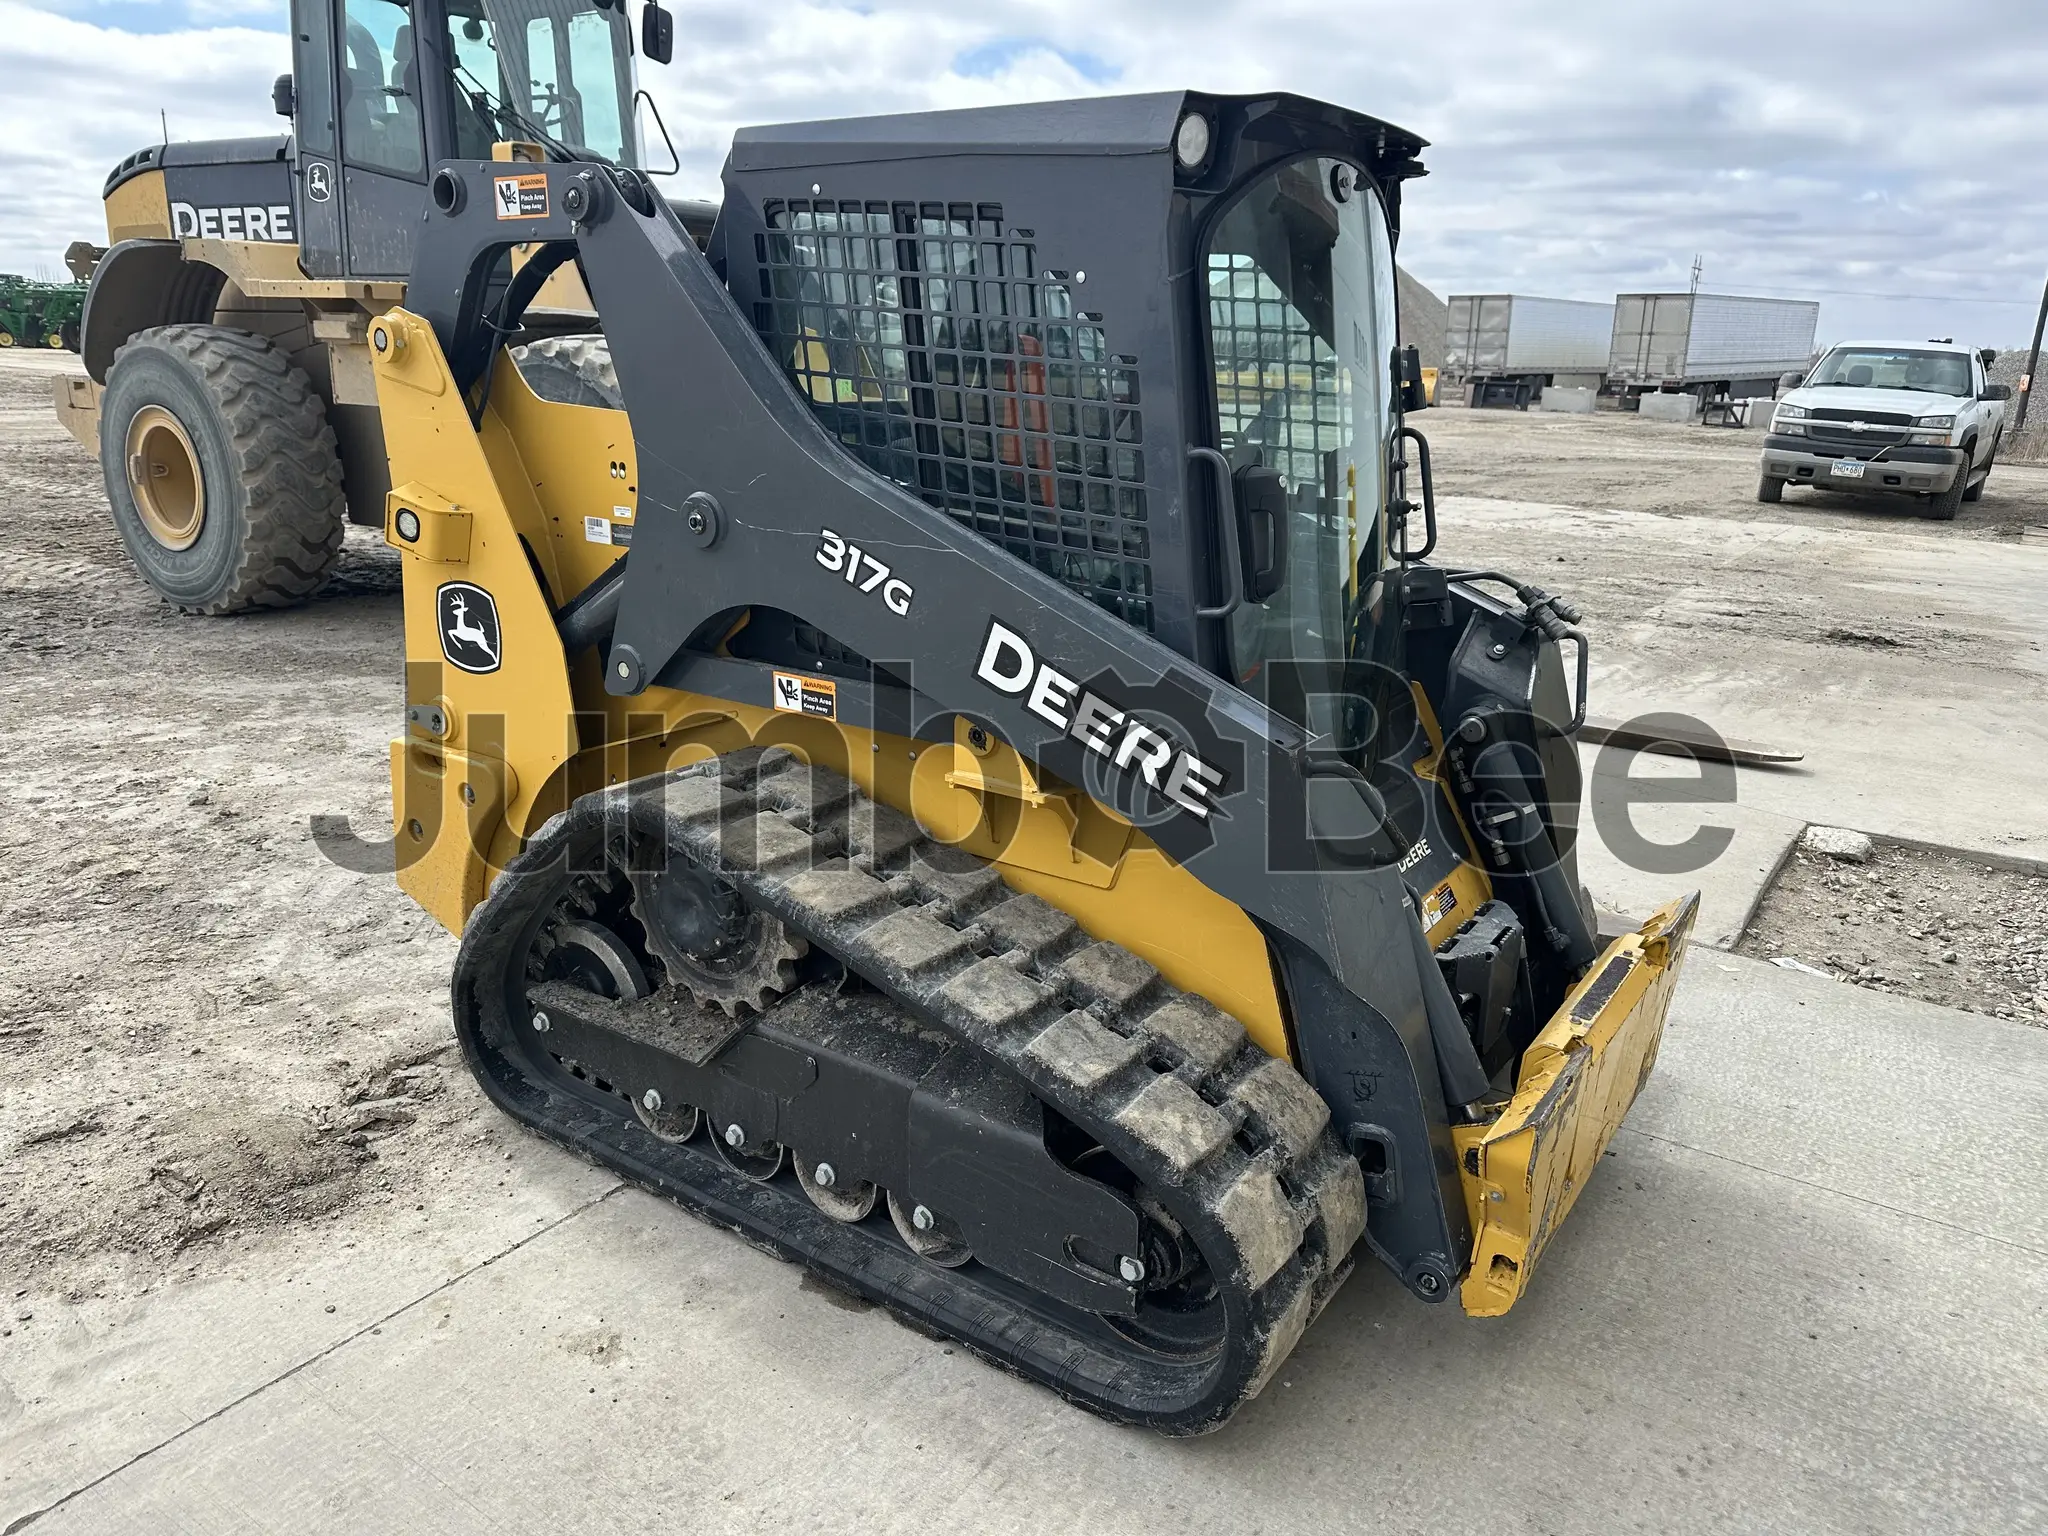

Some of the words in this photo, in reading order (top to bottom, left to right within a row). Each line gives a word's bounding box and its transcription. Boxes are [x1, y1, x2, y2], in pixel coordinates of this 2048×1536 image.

[520, 194, 534, 202] Pinch
[170, 202, 293, 240] DEERE
[815, 529, 914, 616] 317G
[808, 682, 832, 691] WARNING
[802, 693, 819, 703] Pinch
[819, 697, 832, 706] Area
[803, 702, 815, 711] Keep
[815, 705, 829, 714] Away
[977, 621, 1224, 819] DEERE
[1397, 838, 1432, 873] DEERE
